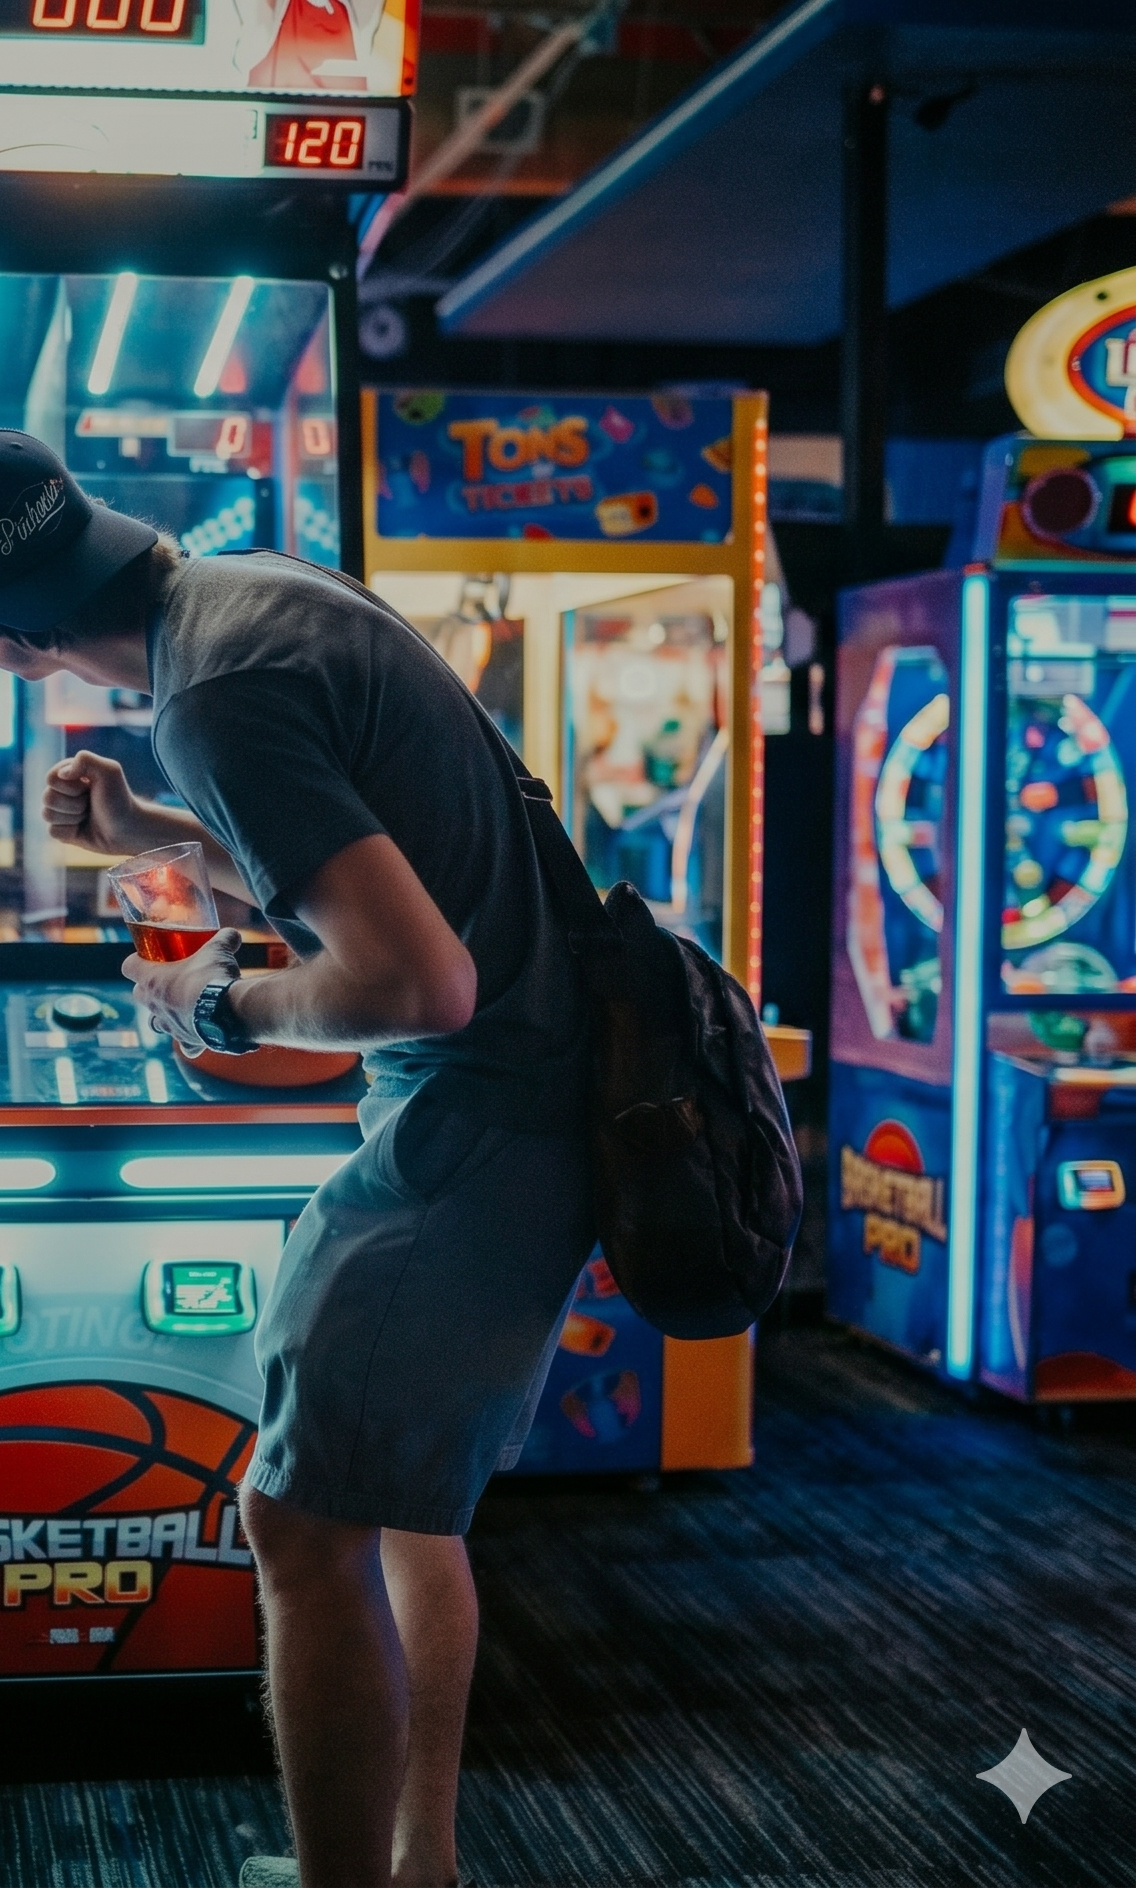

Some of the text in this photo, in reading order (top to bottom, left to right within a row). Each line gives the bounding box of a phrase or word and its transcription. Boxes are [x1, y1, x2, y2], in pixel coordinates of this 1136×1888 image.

[284, 121, 362, 165] 120
[448, 415, 589, 482] TONS
[3, 1560, 153, 1607] PRO
